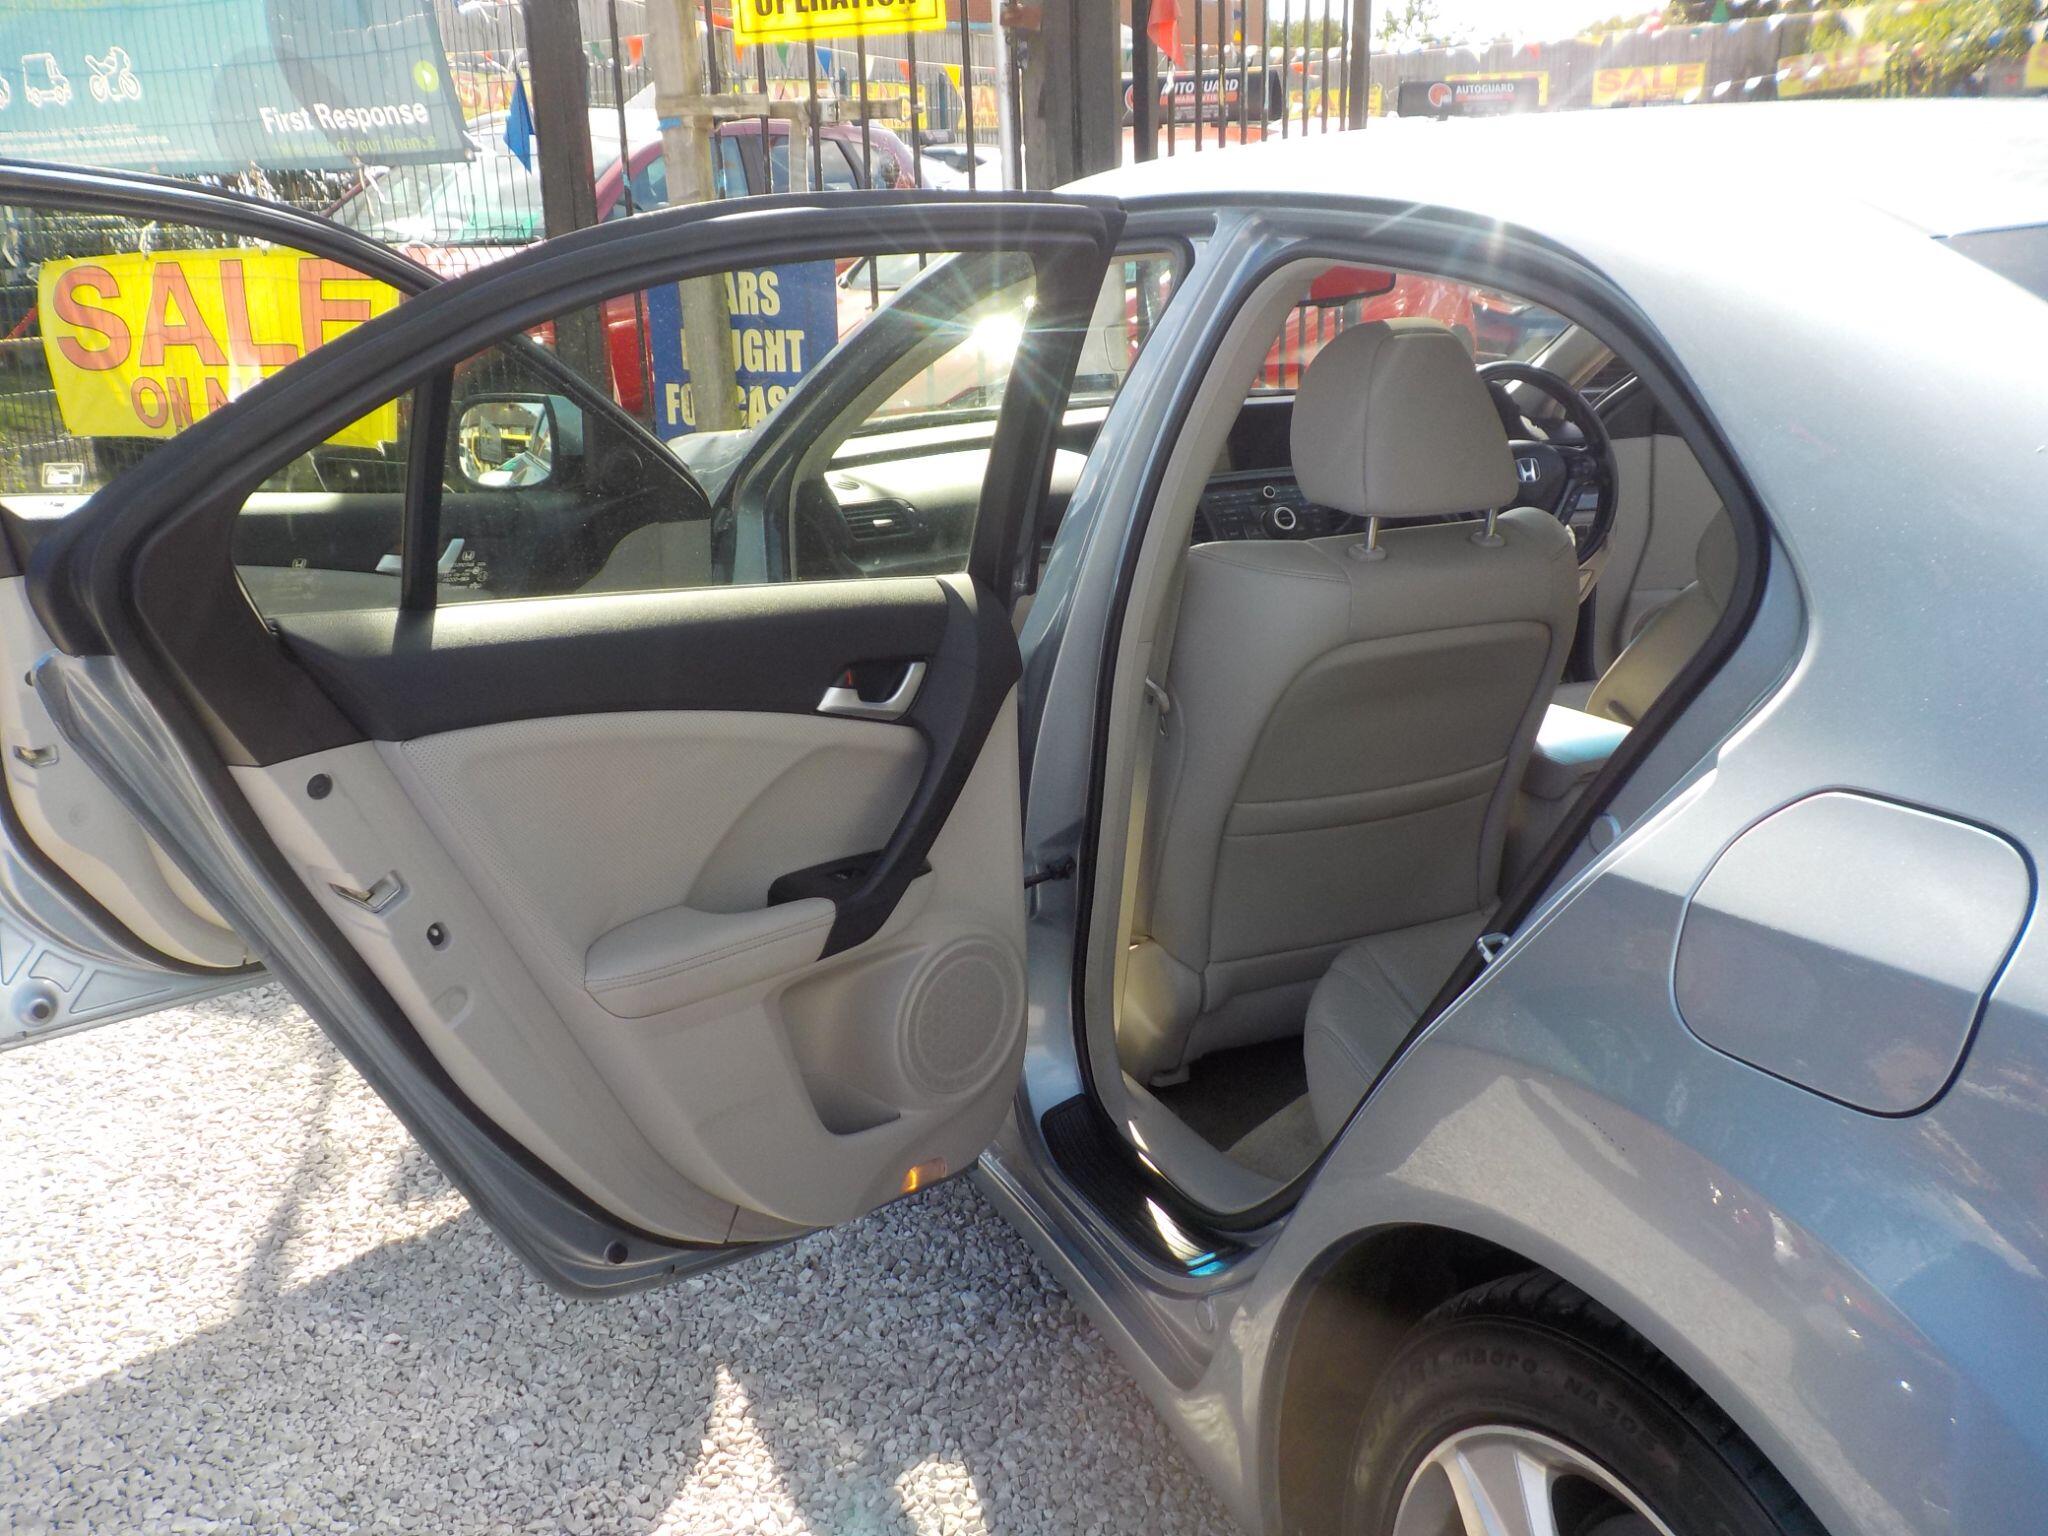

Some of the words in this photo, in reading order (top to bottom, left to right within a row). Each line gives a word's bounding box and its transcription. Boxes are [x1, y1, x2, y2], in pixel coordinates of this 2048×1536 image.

[1456, 83, 1515, 95] AUTOGUARD
[1598, 64, 1700, 93] SALE
[259, 106, 314, 134] First
[313, 102, 430, 134] Response
[723, 271, 781, 316] ARS
[130, 376, 194, 429] ON
[665, 383, 697, 427] FO
